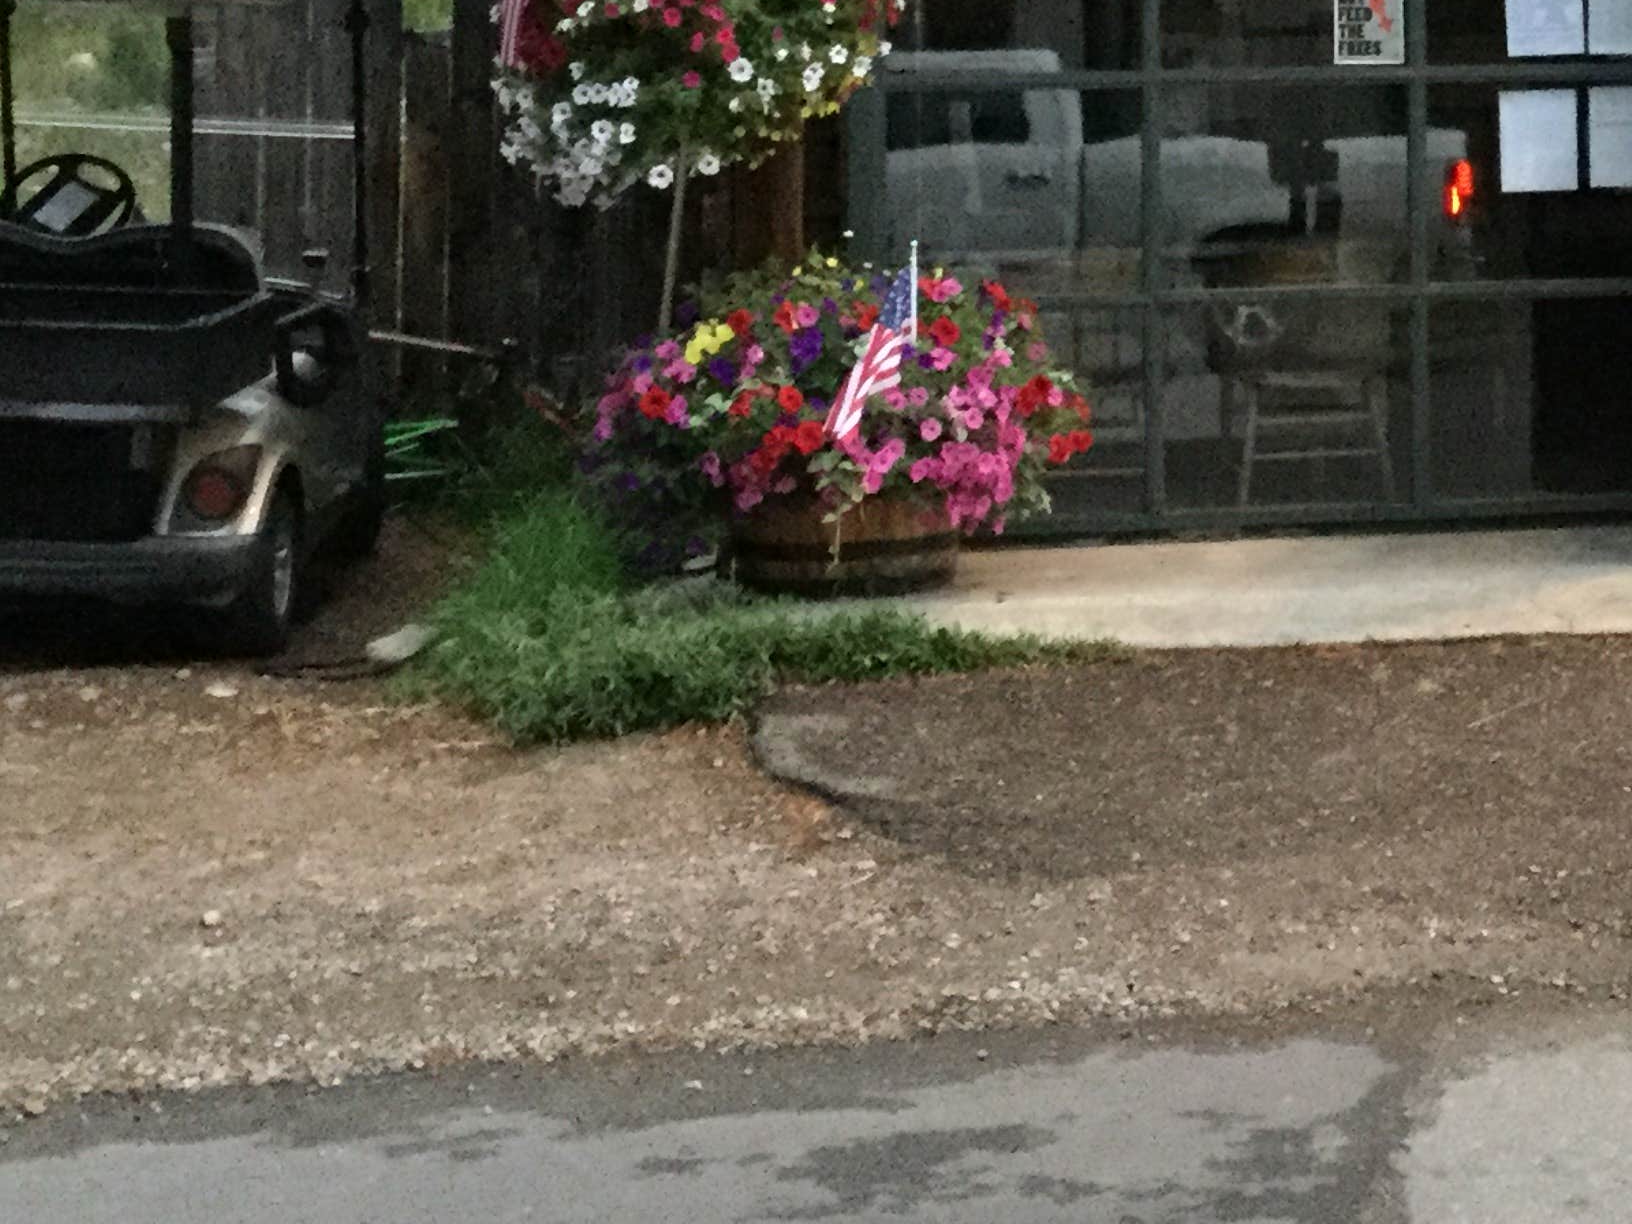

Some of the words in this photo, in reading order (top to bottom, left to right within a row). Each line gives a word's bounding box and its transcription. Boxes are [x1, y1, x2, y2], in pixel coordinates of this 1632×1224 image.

[1338, 6, 1373, 23] FEED
[1338, 23, 1365, 39] THE
[1338, 40, 1382, 56] FOXES
